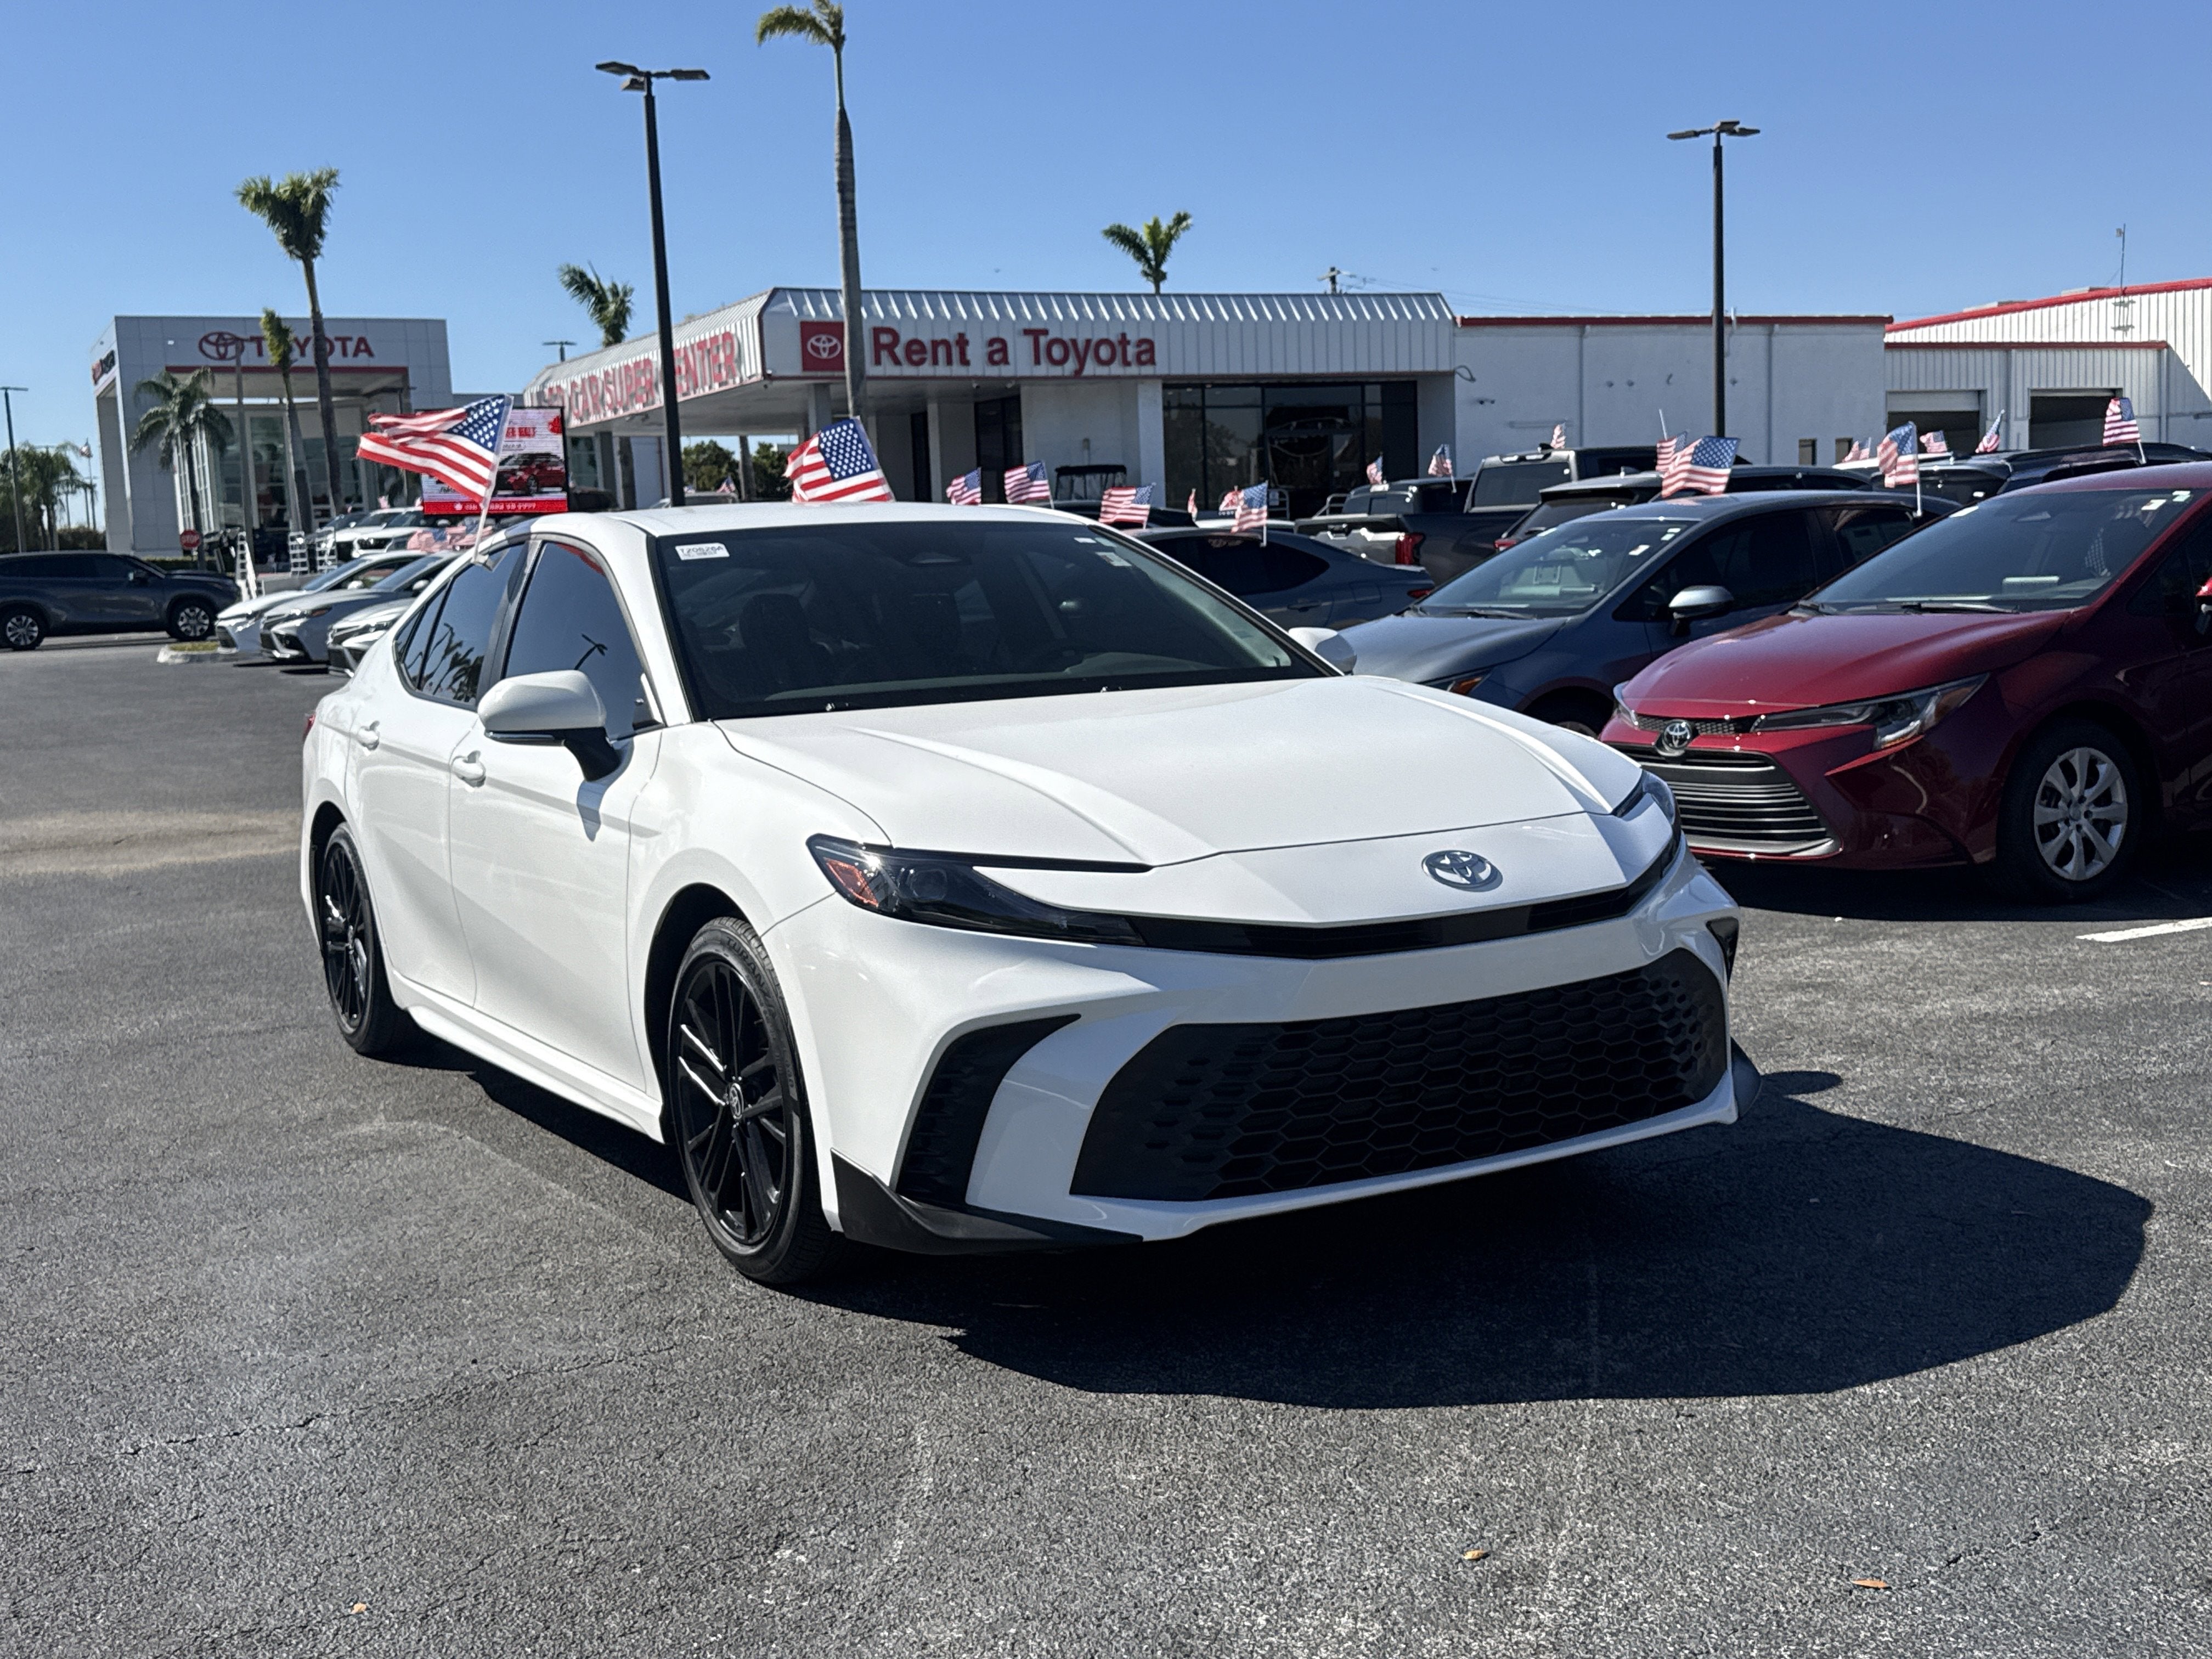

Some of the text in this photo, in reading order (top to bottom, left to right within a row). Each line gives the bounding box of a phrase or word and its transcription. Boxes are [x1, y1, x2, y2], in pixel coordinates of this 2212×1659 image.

[250, 336, 375, 358] TYTA
[872, 326, 1156, 377] Rent a Toyota
[571, 375, 602, 420] CAR
[604, 358, 657, 413] SUPER
[673, 331, 737, 395] ENTER
